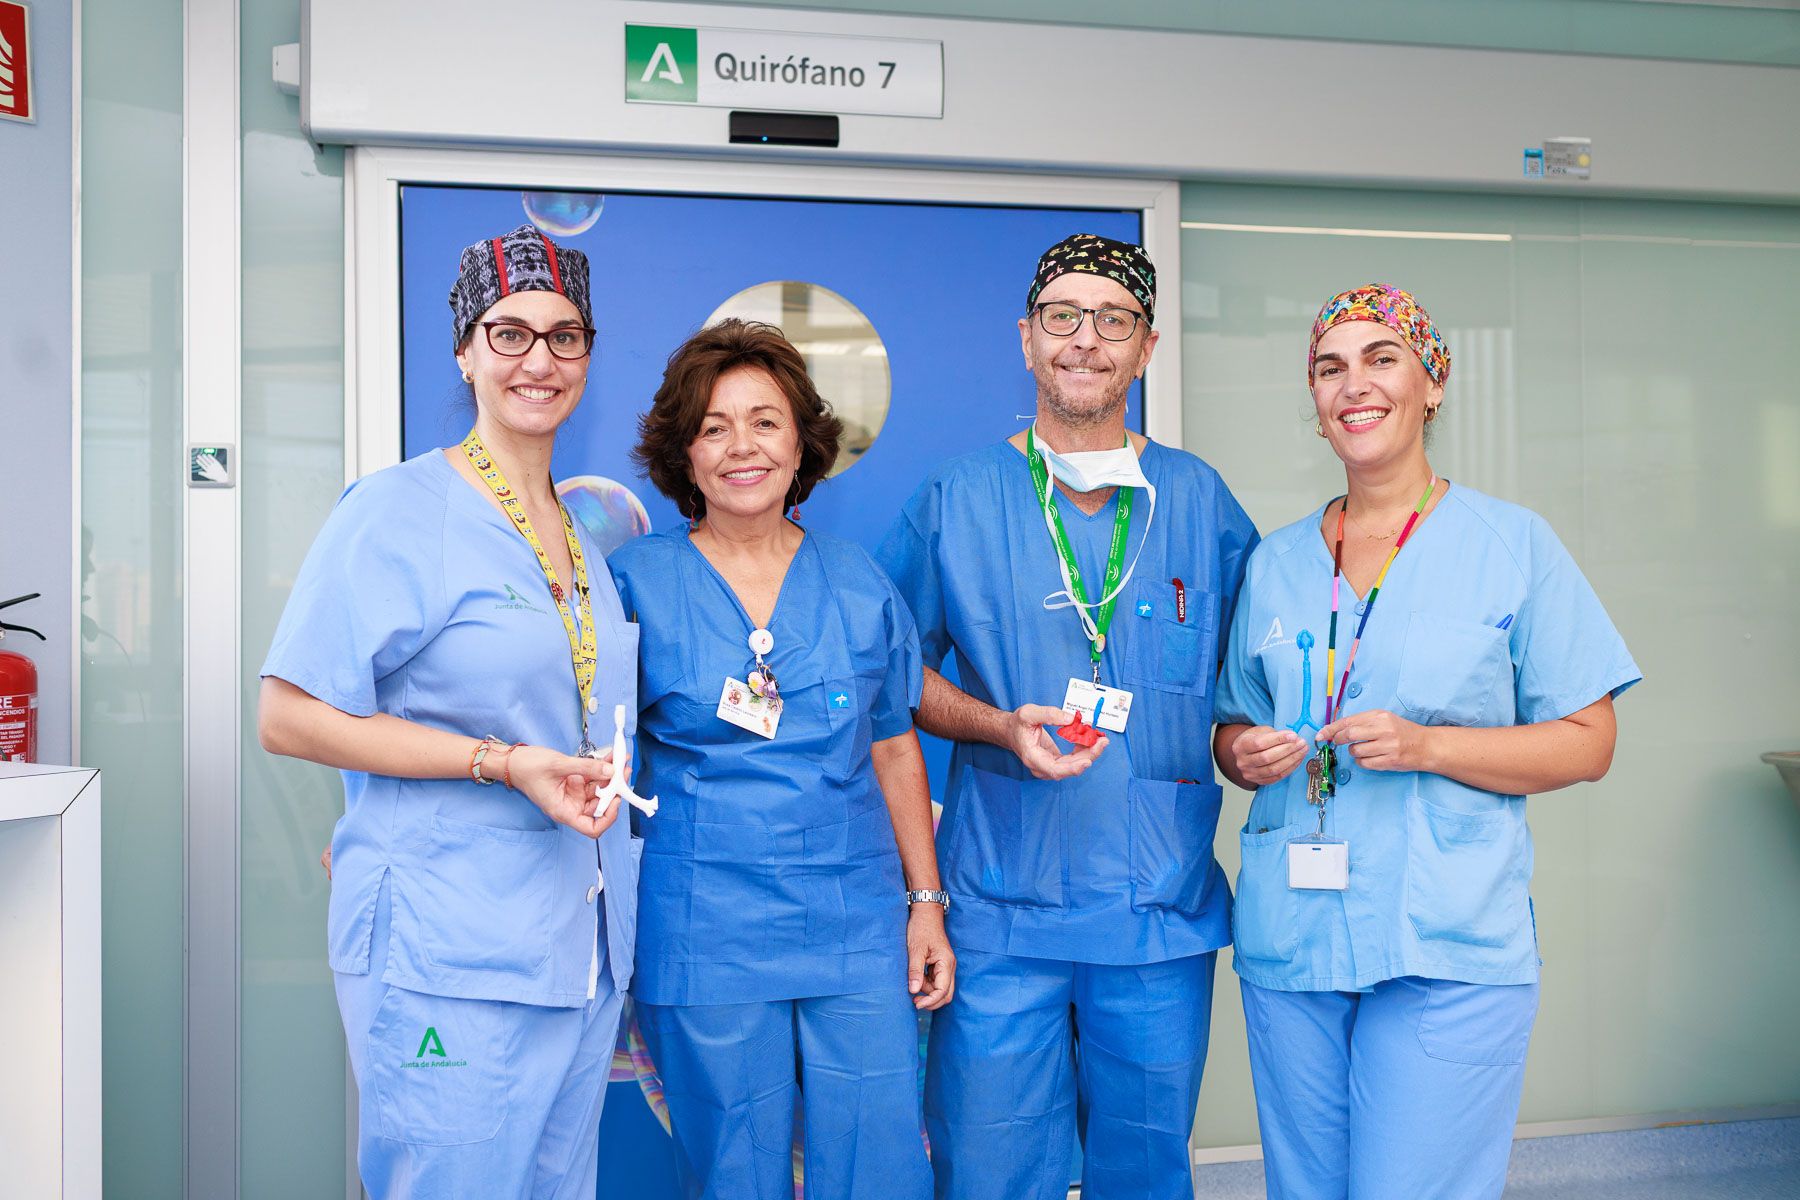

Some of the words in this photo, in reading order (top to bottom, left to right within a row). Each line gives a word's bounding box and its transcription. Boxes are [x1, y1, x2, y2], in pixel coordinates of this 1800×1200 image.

[714, 52, 866, 88] Quirófano
[878, 61, 898, 89] 7
[400, 1059, 419, 1068] Junta
[431, 1059, 467, 1067] Andalucía
